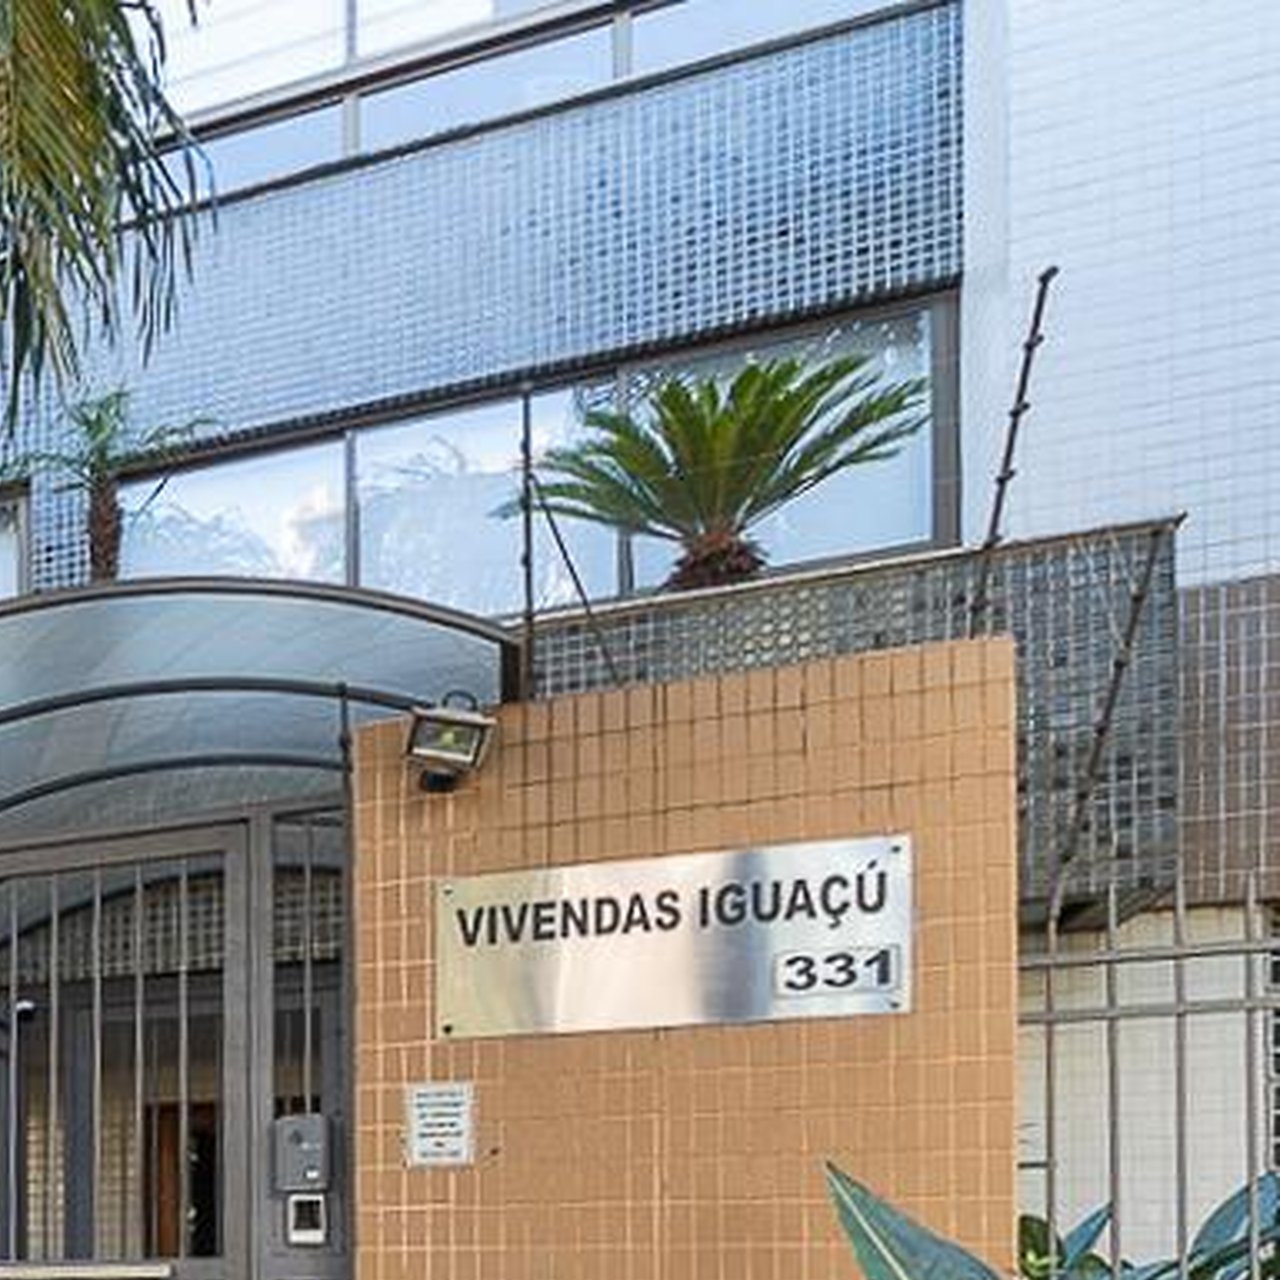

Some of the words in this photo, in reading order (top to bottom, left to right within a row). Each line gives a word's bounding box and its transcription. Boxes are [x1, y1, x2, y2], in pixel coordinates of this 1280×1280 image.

[457, 889, 681, 947] VIVENDAS
[699, 861, 888, 929] IGUAÇÚ
[784, 949, 893, 991] 331
